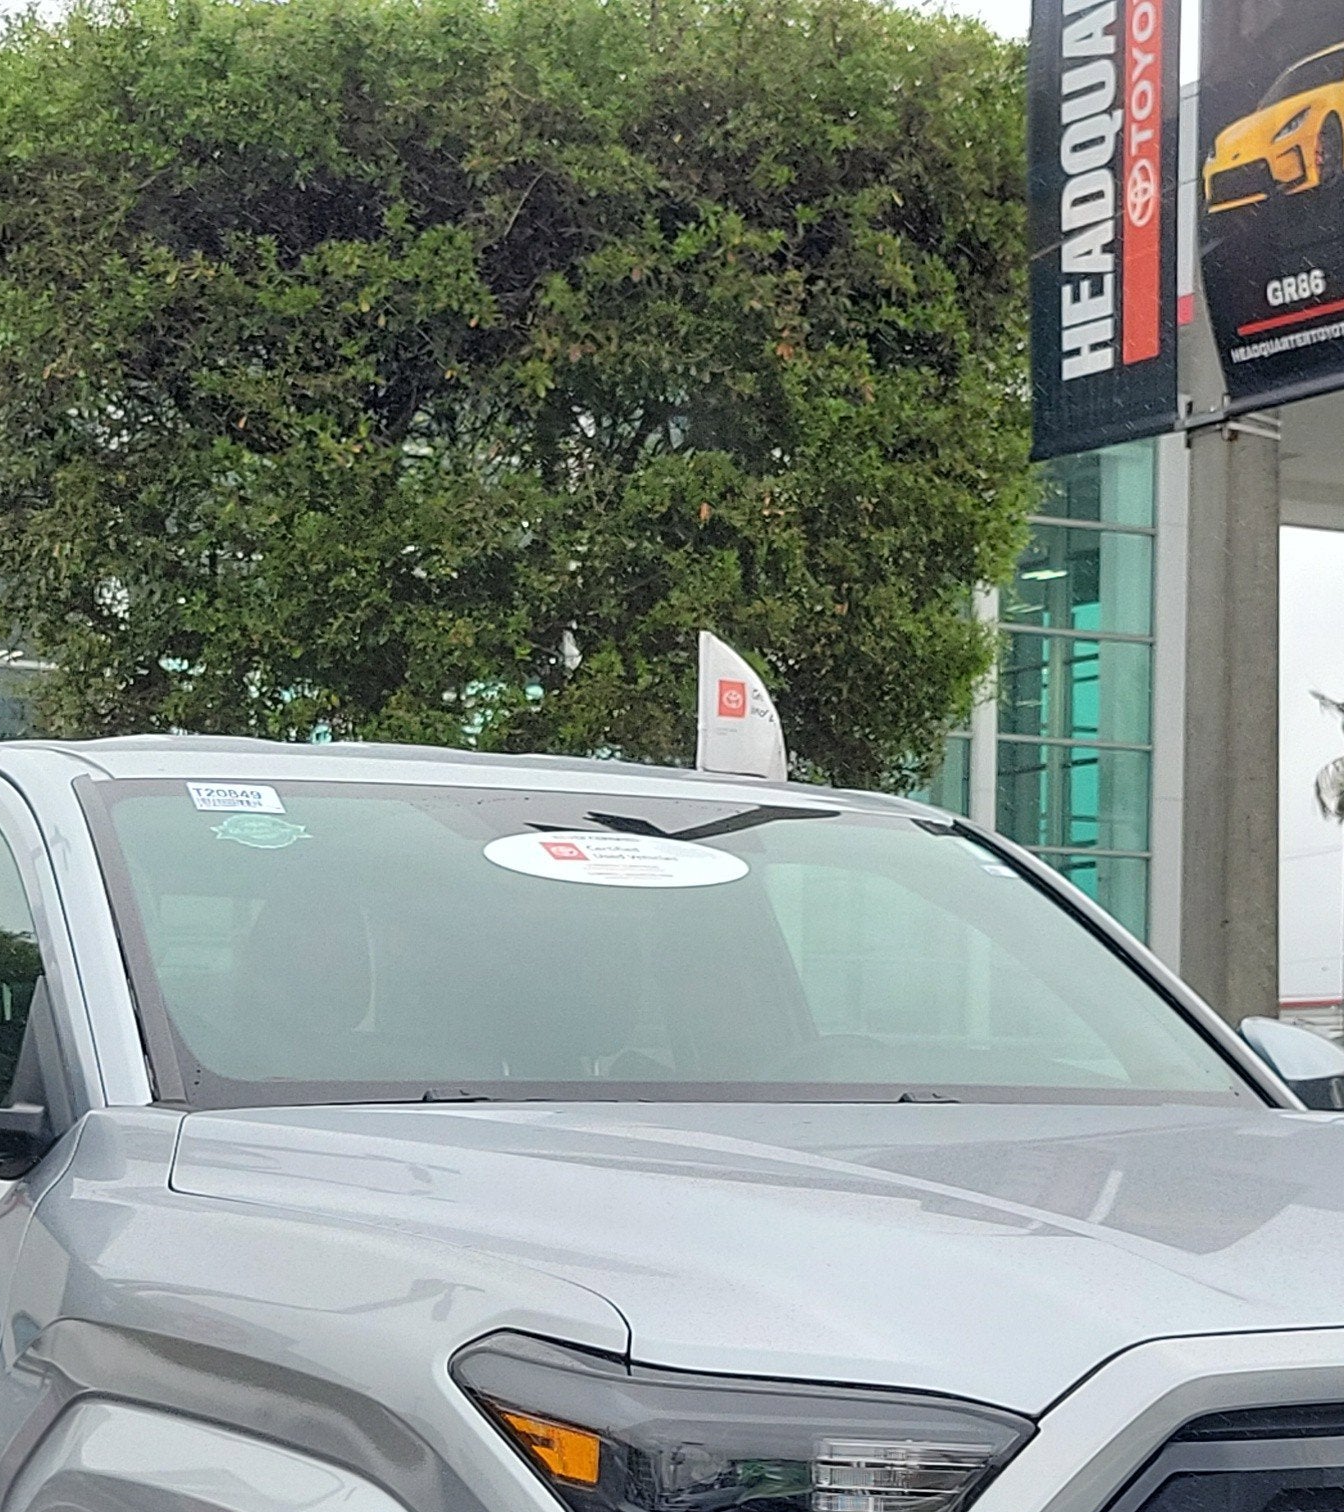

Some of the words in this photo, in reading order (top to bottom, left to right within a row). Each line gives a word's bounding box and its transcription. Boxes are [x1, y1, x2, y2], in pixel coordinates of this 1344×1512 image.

[1130, 0, 1157, 155] TOYO
[1061, 0, 1124, 382] HEADQUA
[1266, 268, 1327, 307] GR86
[192, 787, 262, 800] T20849
